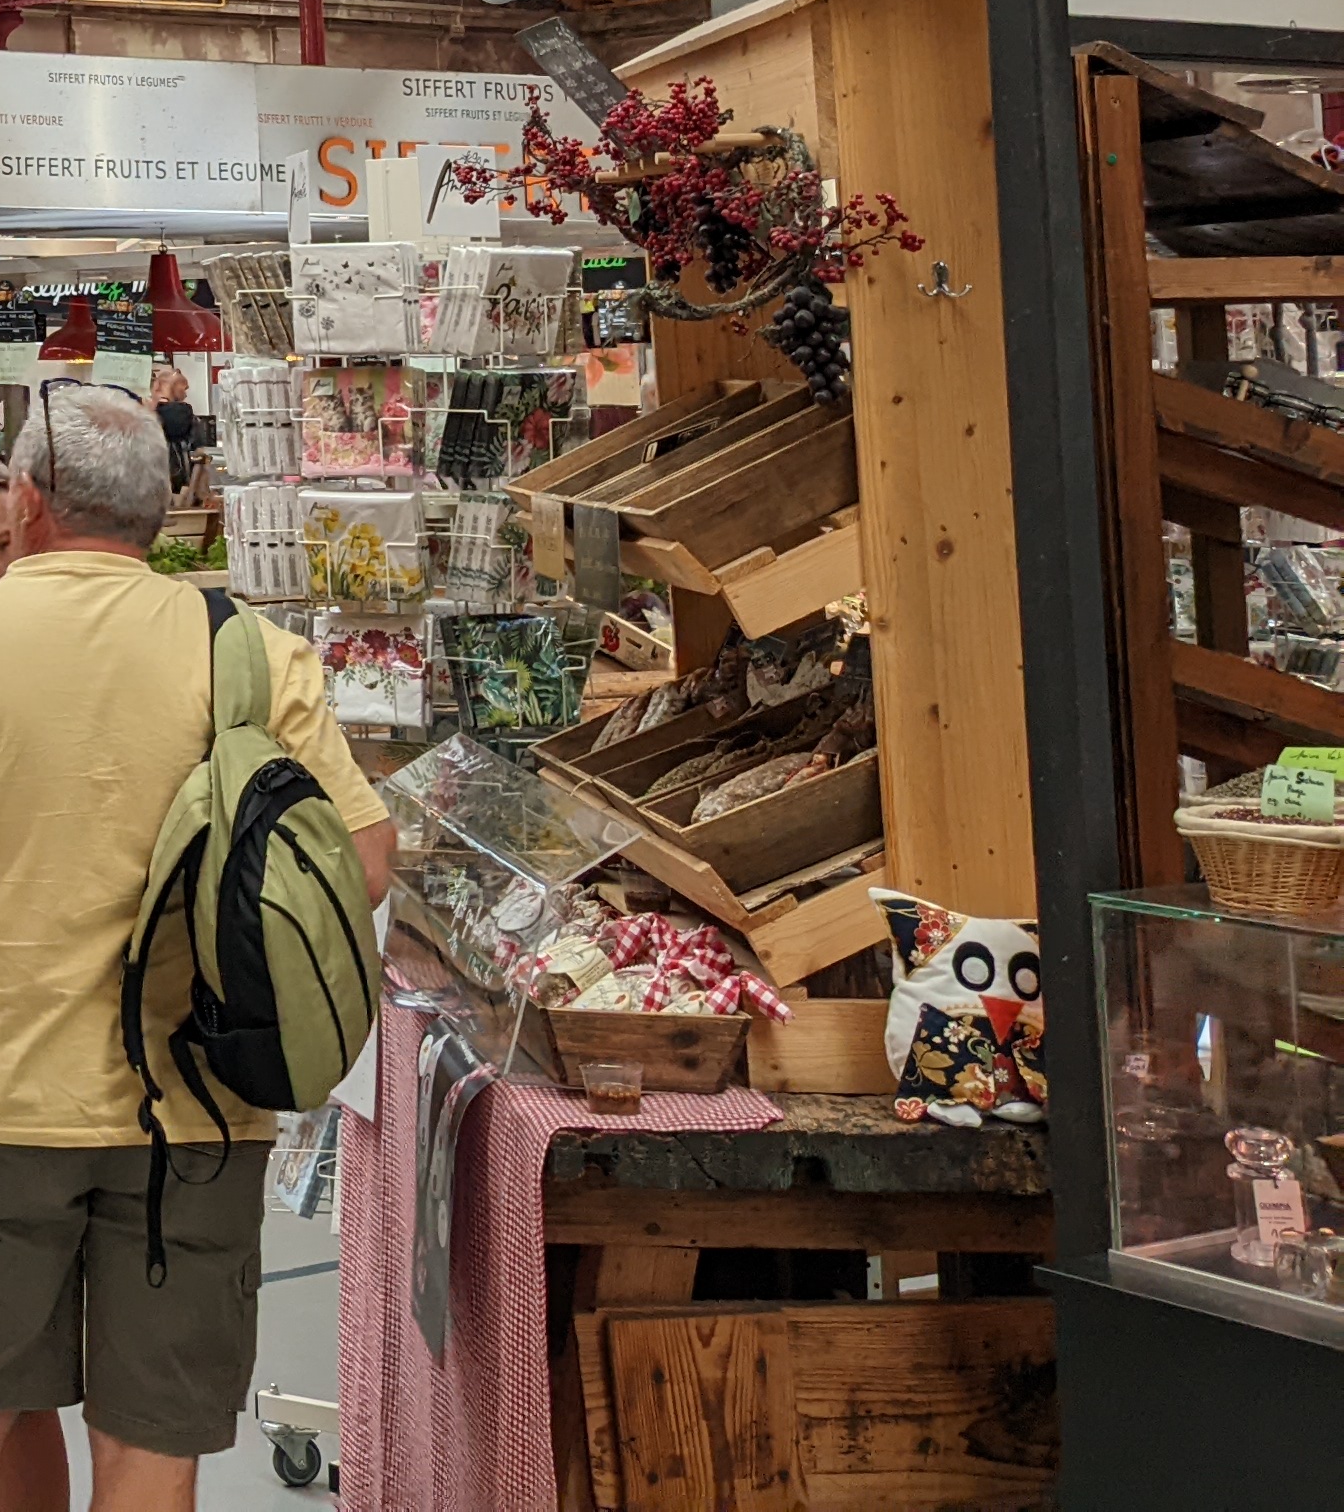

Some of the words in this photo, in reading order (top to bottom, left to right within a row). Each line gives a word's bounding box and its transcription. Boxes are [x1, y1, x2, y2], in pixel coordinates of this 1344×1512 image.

[48, 72, 85, 84] SIFFERT
[88, 74, 124, 86] FRUTOS
[127, 76, 133, 86] Y
[135, 76, 178, 88] LEGUMES
[402, 78, 477, 99] SIFFERT
[20, 114, 63, 126] VERDURE
[257, 113, 292, 124] SIFFERT
[335, 116, 373, 128] VERDURE
[425, 107, 459, 118] SIFFERT
[461, 108, 491, 120] FRUITS
[493, 110, 503, 121] ET
[1, 156, 86, 178] SIFFERT
[94, 159, 167, 179] FRUITS
[176, 161, 199, 180] ET
[208, 161, 286, 183] LEGUME
